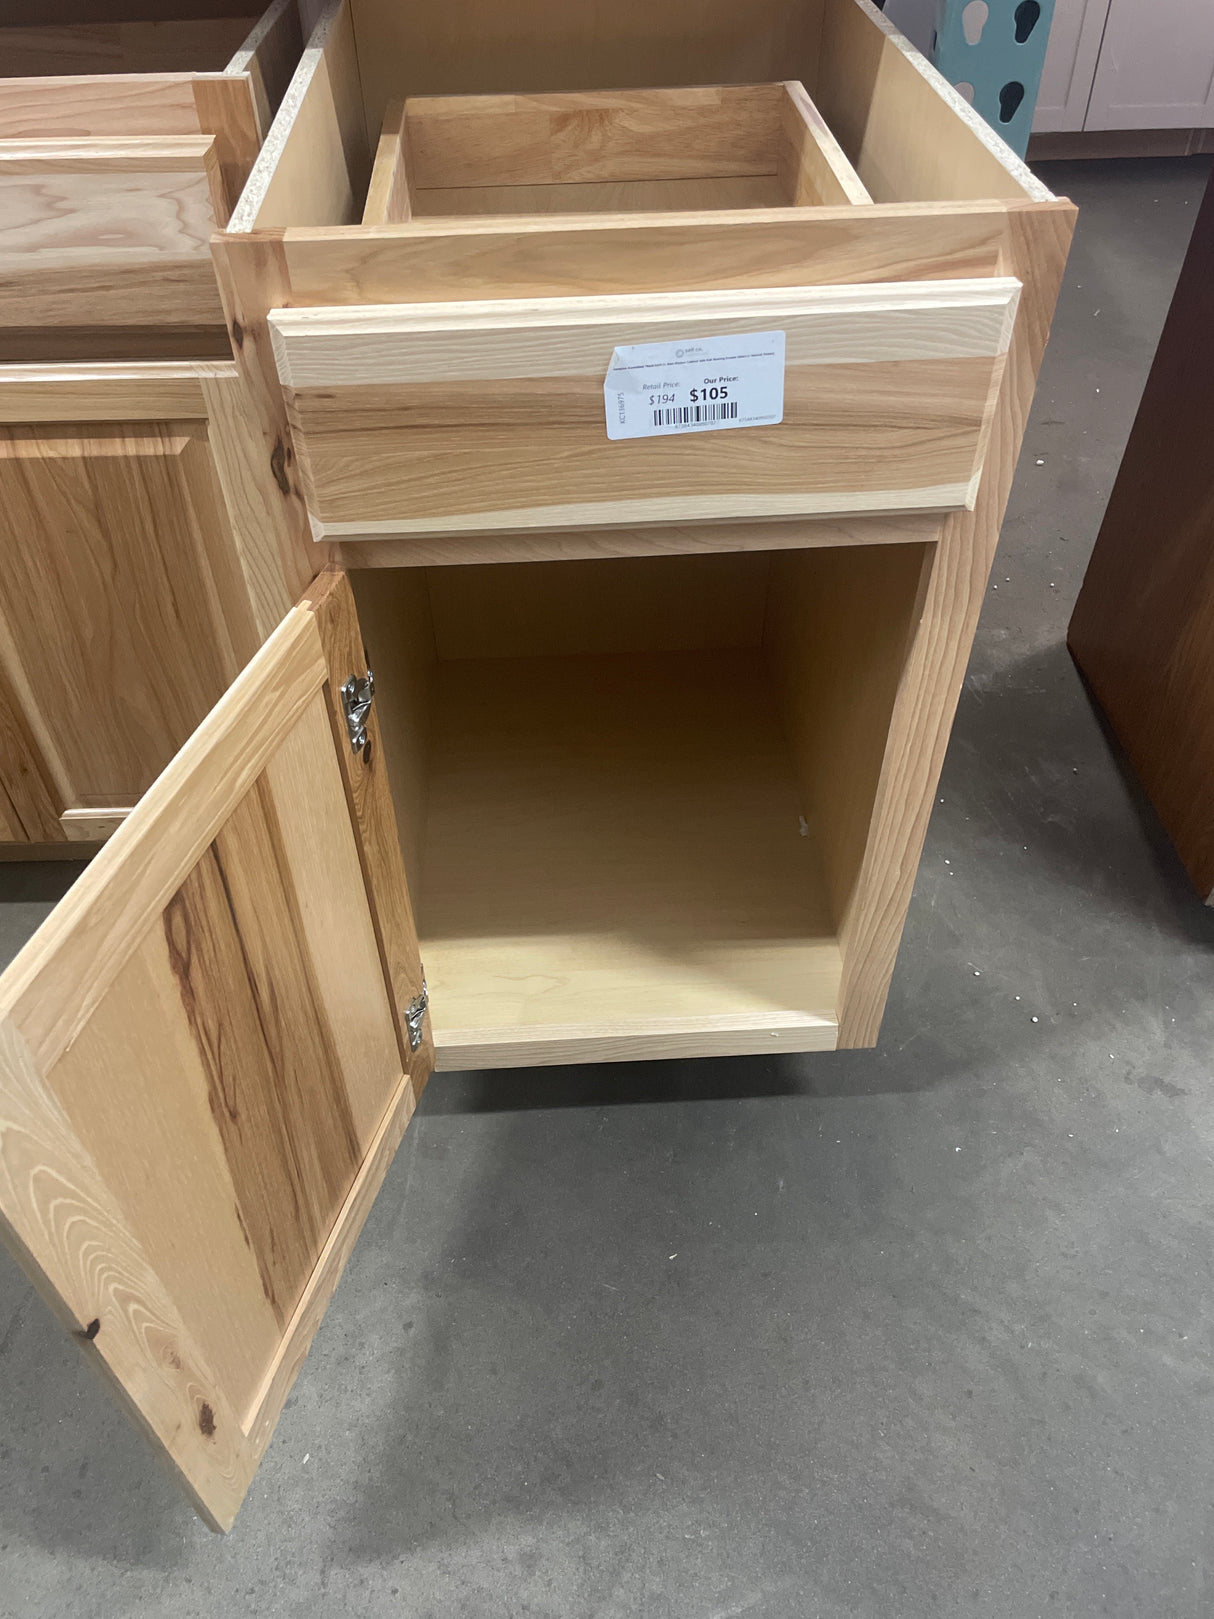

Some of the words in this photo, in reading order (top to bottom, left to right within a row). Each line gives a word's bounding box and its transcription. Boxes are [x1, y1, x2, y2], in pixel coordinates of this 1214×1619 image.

[642, 382, 661, 390] Retail
[662, 381, 680, 389] Price:
[703, 377, 717, 385] Our
[718, 375, 739, 383] Price:
[649, 393, 676, 406] $194
[689, 386, 729, 403] $105
